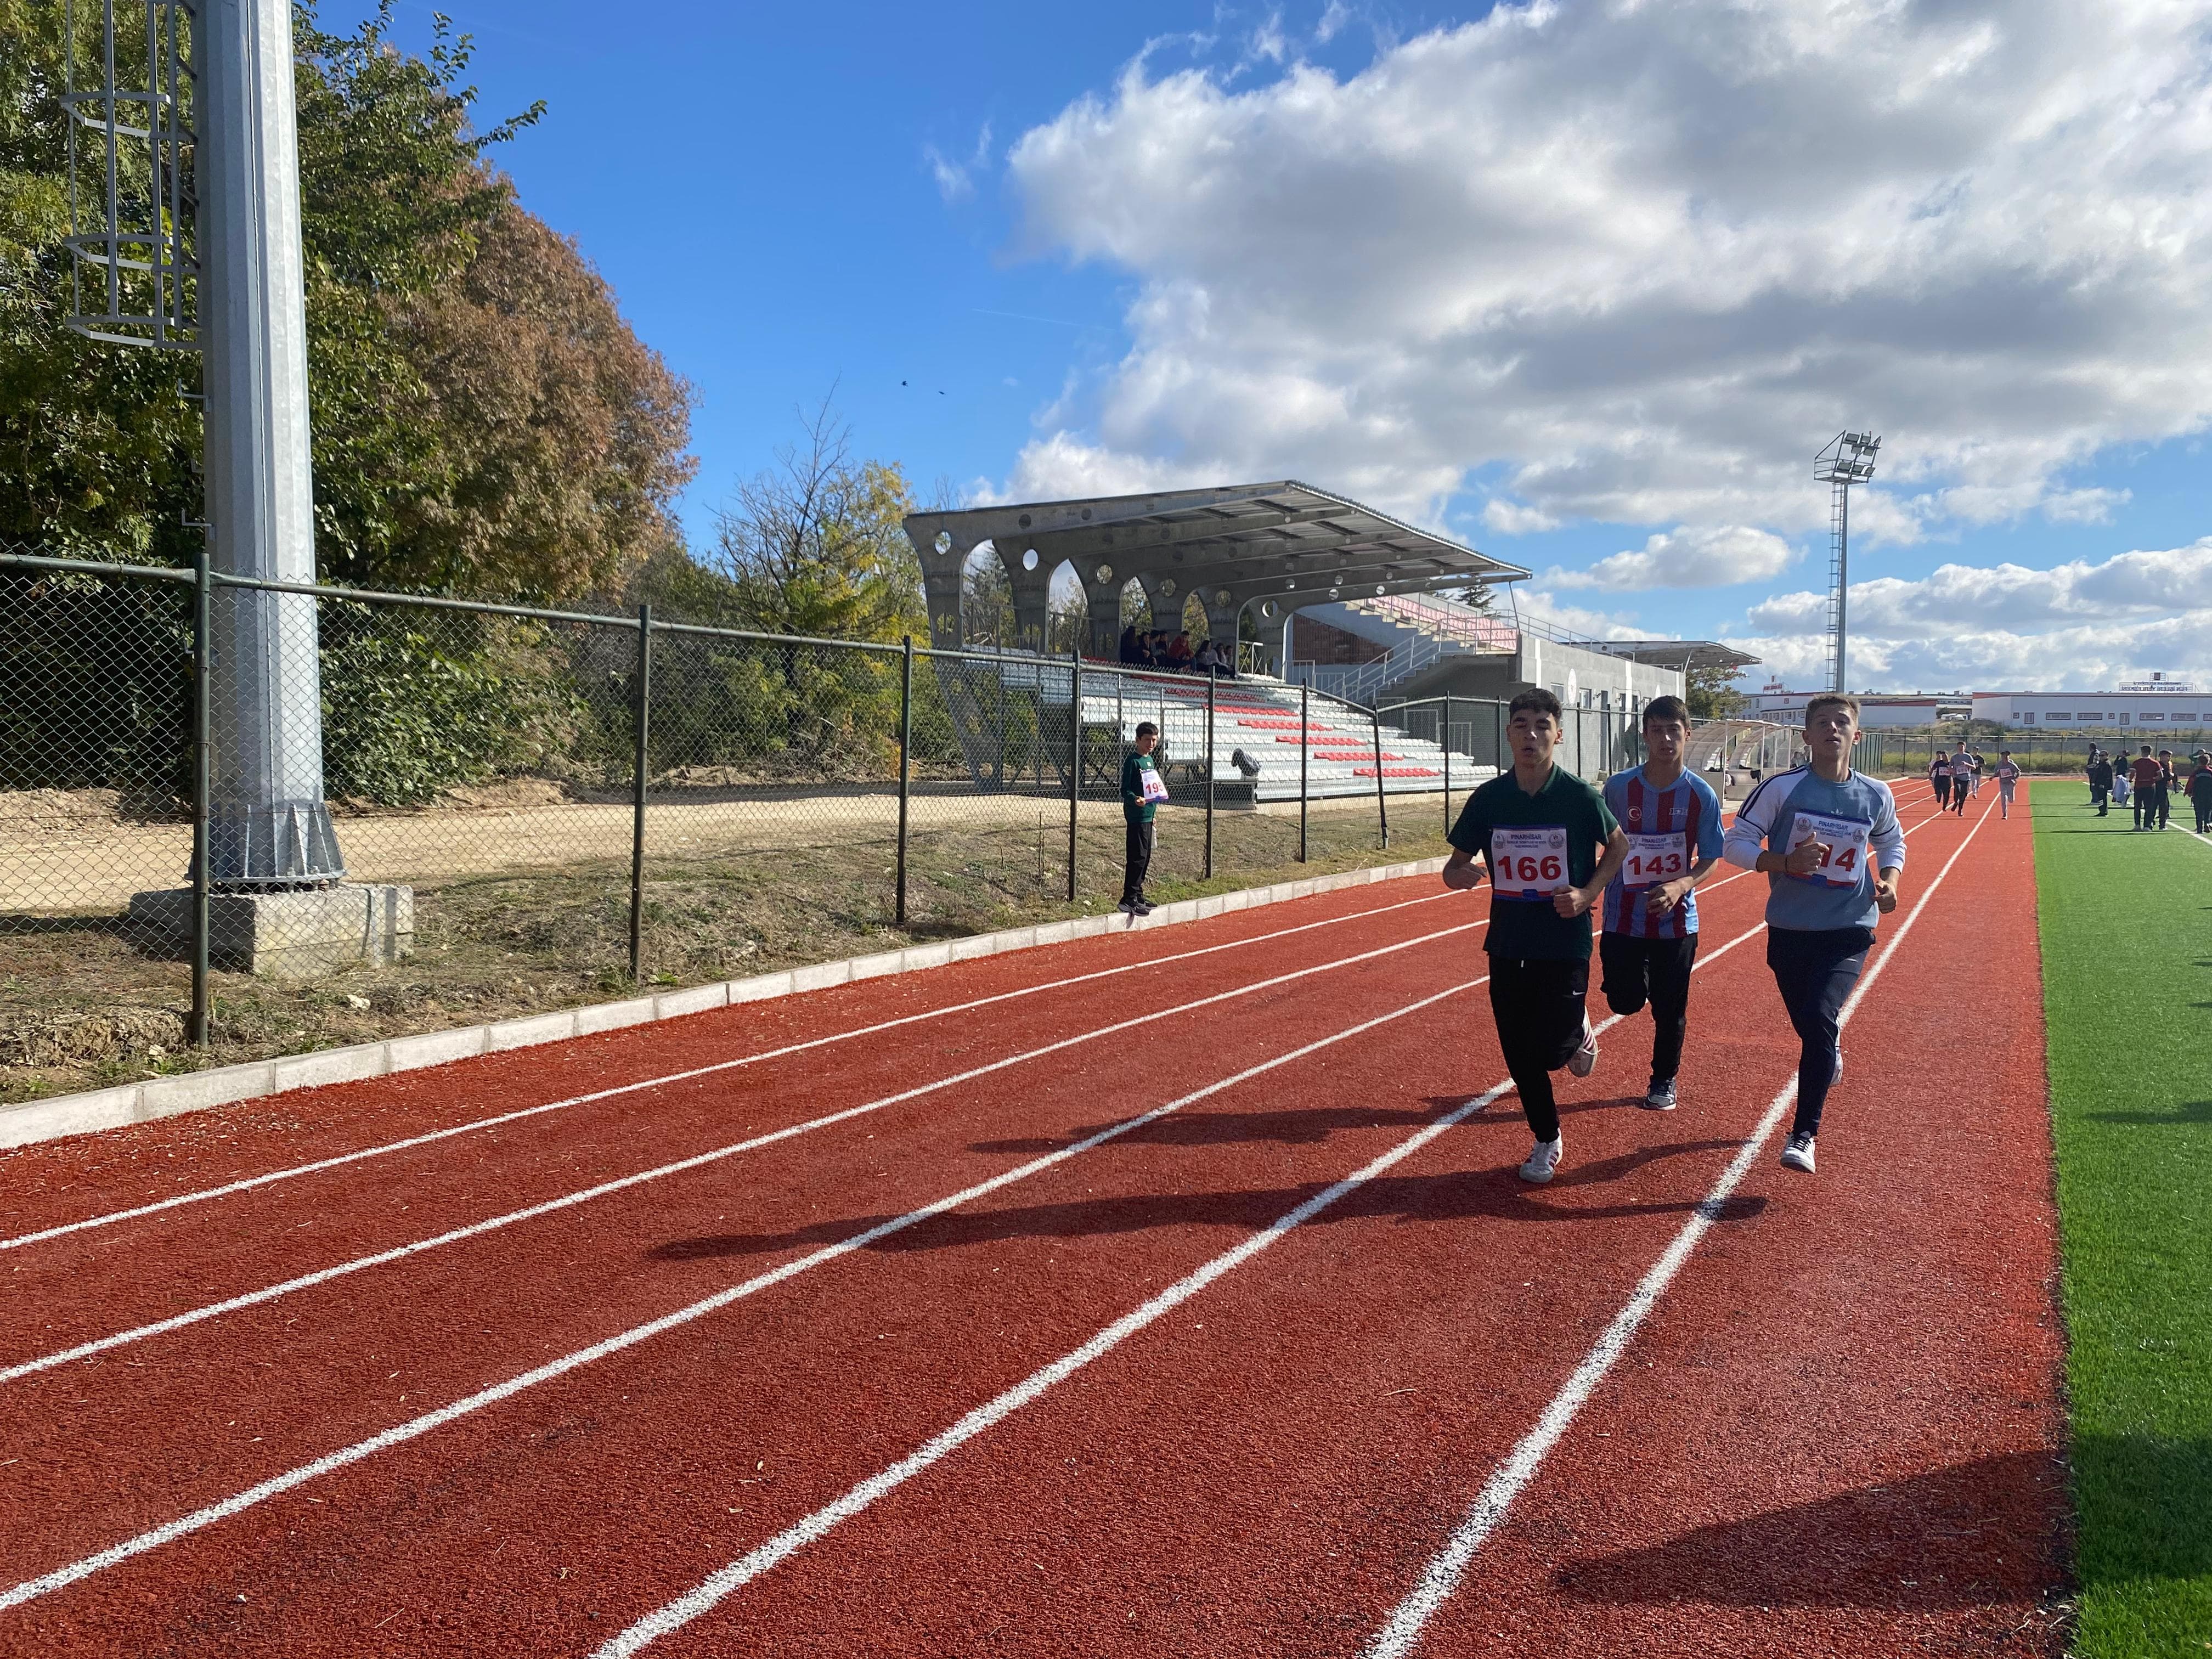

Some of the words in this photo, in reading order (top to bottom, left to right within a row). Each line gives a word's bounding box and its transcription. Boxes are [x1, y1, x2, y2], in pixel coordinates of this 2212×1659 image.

[1498, 855, 1561, 882] 166
[1628, 853, 1681, 876] 143
[1795, 843, 1857, 872] 14
